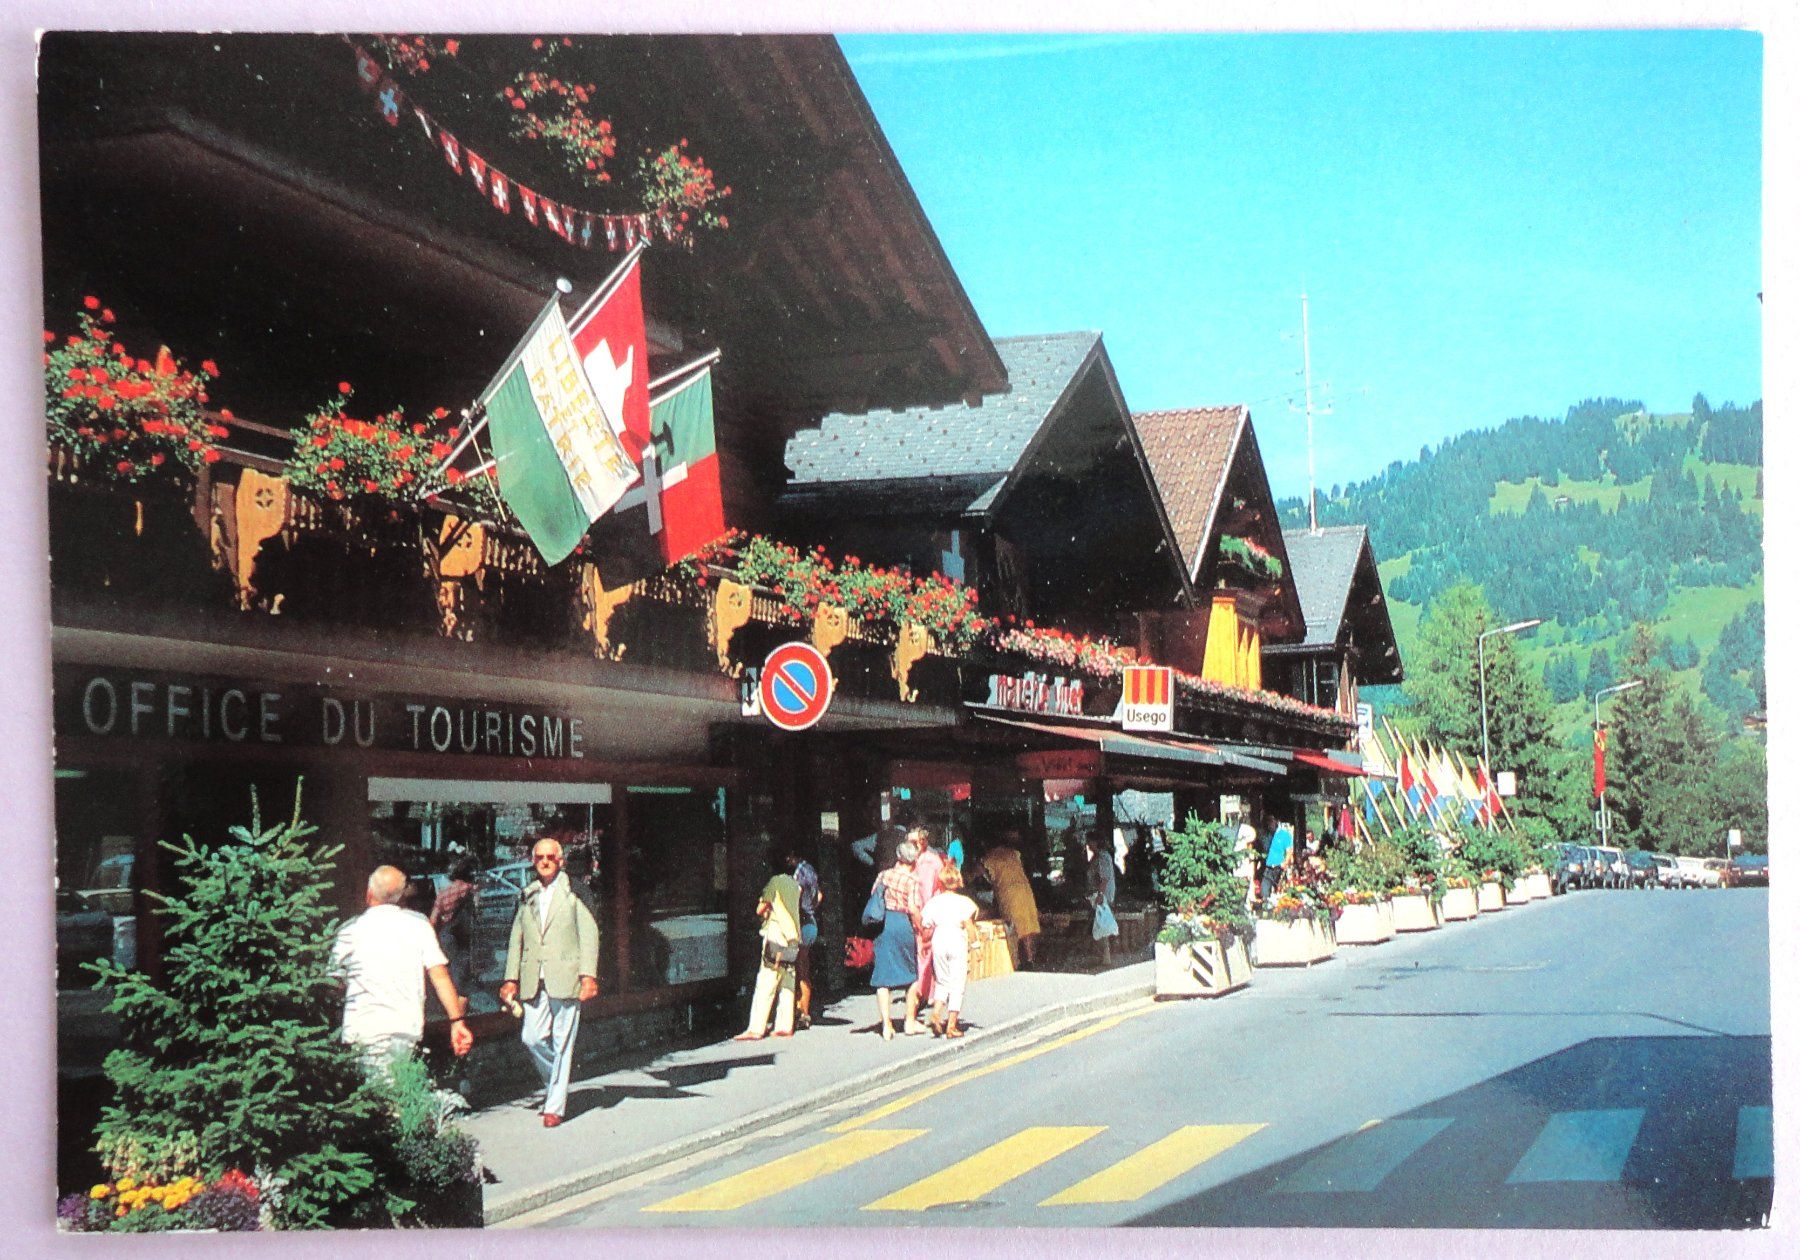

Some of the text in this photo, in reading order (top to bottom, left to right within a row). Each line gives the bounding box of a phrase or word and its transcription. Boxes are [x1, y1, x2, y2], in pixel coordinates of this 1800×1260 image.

[83, 677, 585, 758] OFFICE DU TOURISME
[1126, 708, 1167, 726] Usego
